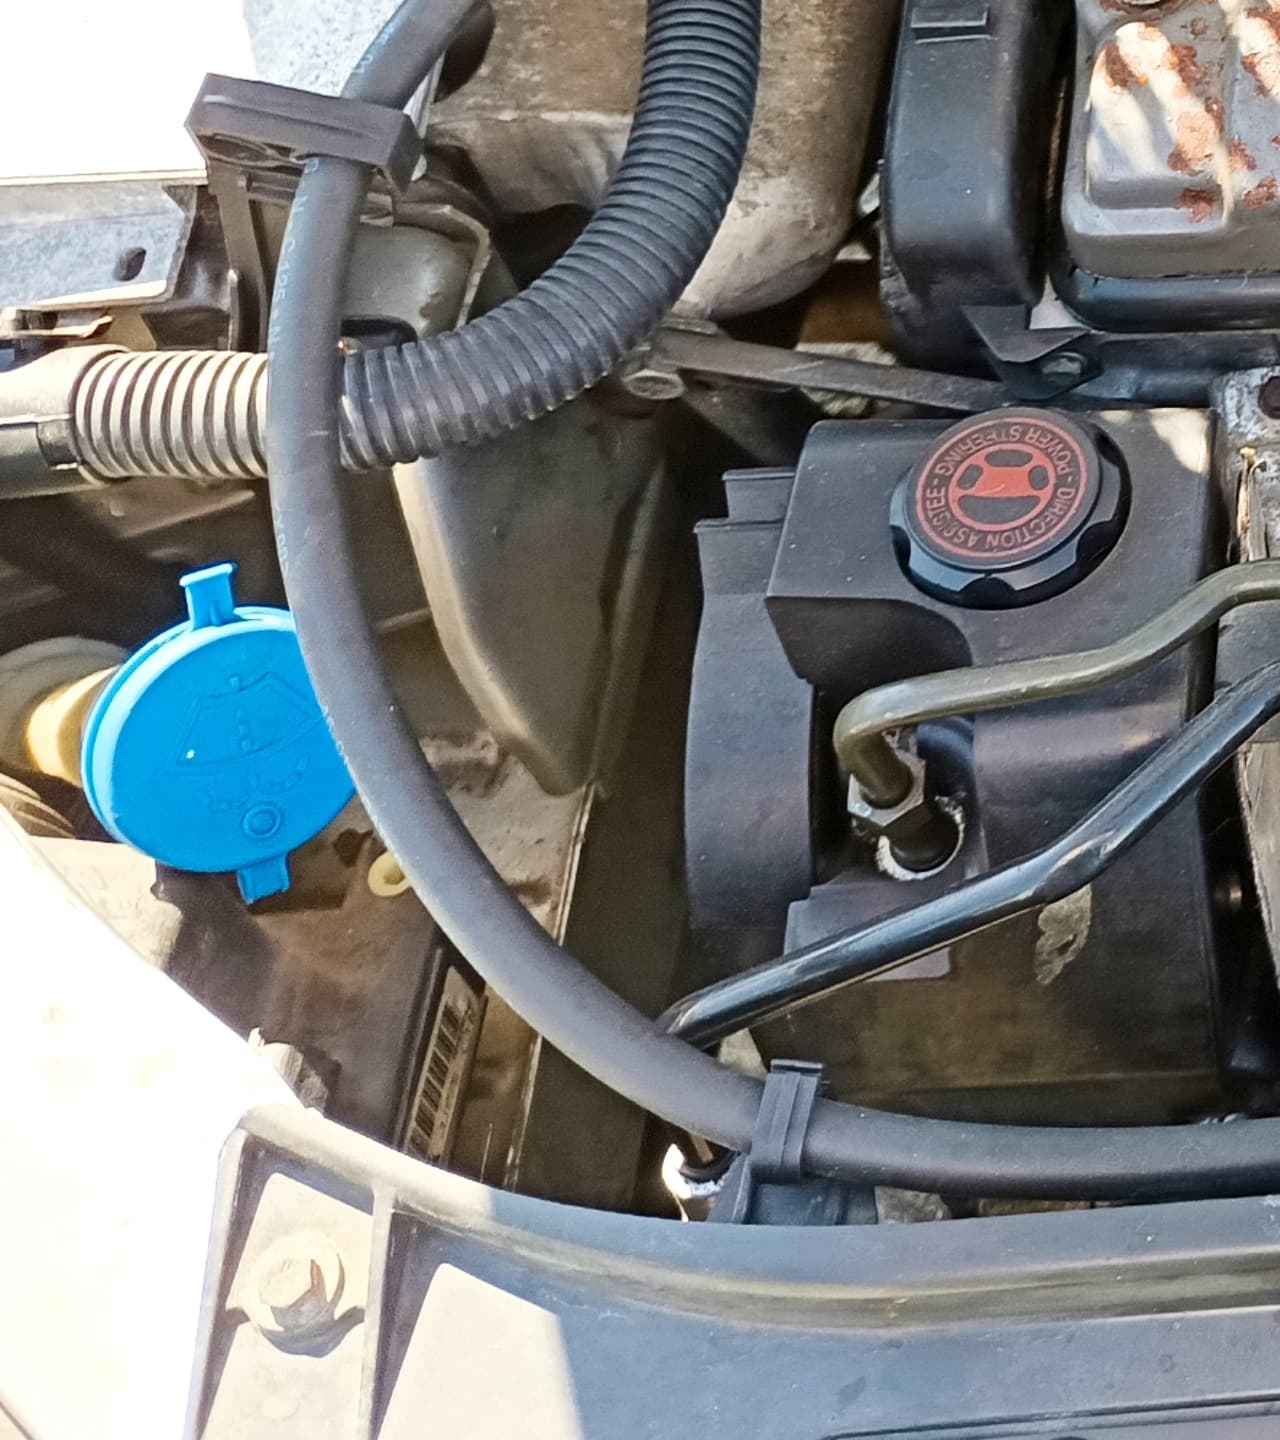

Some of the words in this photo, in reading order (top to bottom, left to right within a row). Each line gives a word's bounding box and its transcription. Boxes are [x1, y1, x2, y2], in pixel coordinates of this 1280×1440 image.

[934, 424, 1023, 477] STEERING
[1024, 428, 1074, 477] POWER
[986, 486, 1077, 546] DIRECTION
